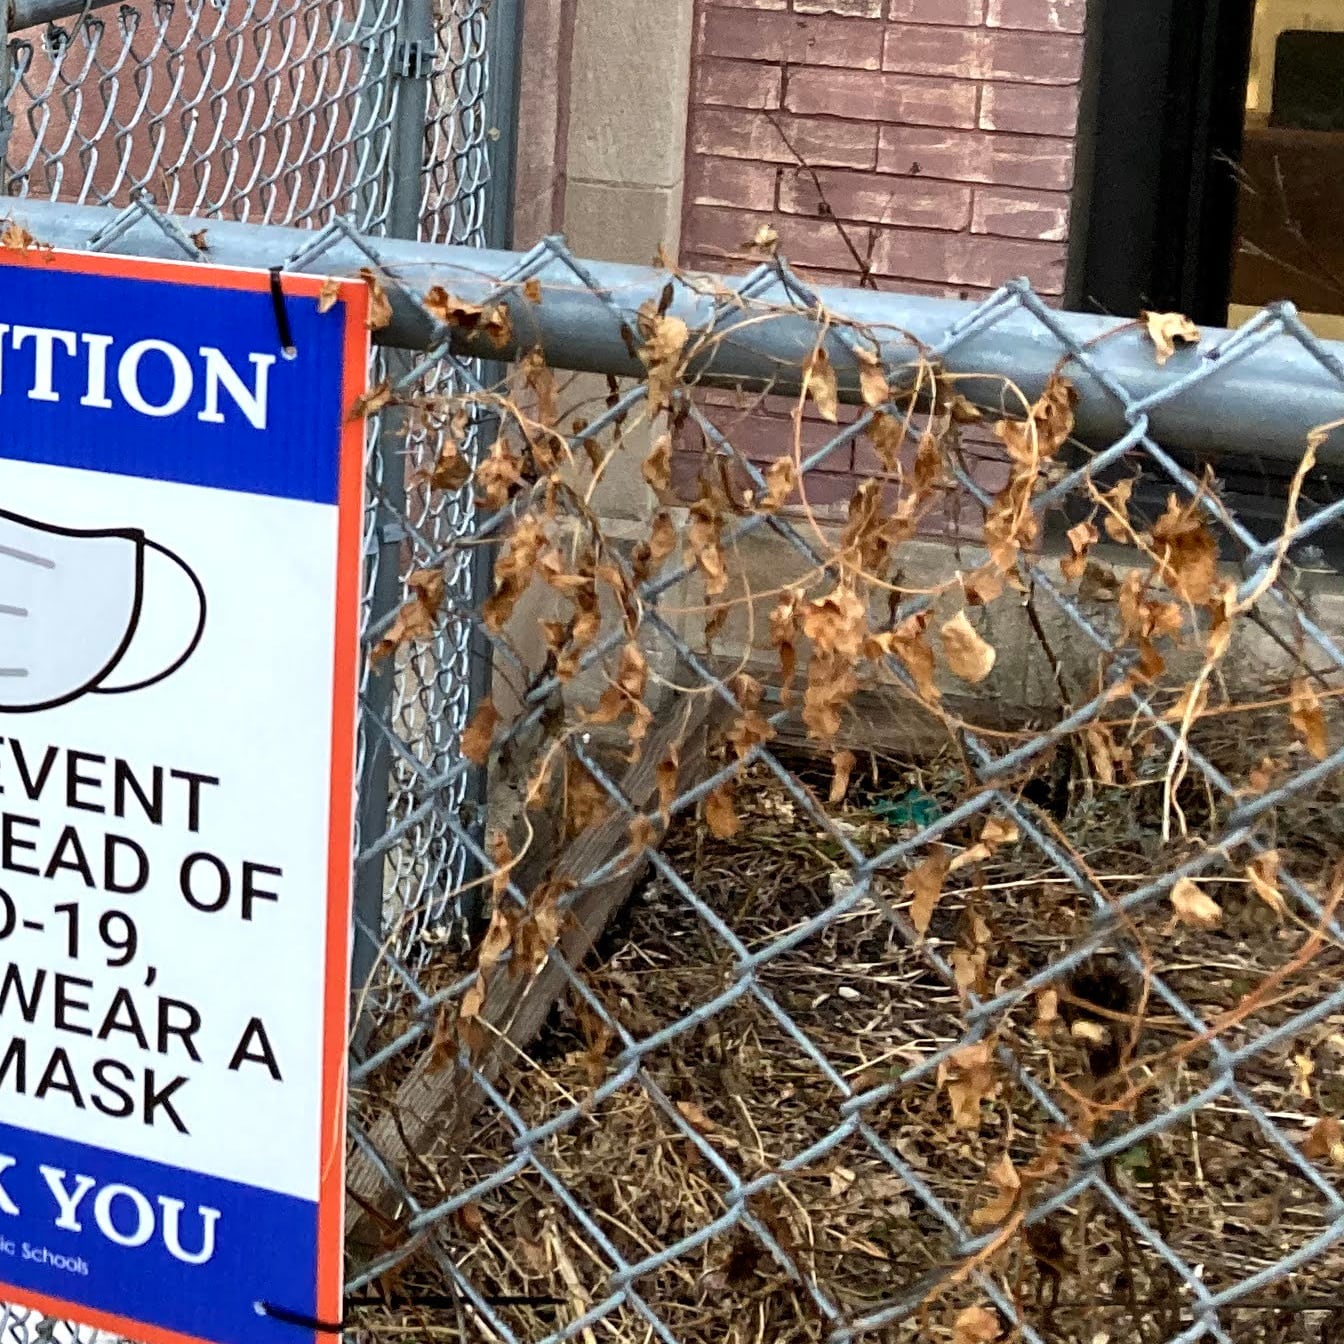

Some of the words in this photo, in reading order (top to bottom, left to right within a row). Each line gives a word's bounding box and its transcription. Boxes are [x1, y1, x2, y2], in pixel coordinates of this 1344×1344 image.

[178, 851, 284, 922] OF
[228, 1016, 284, 1082] A
[39, 1163, 222, 1265] YOU
[21, 1242, 89, 1277] Schools
